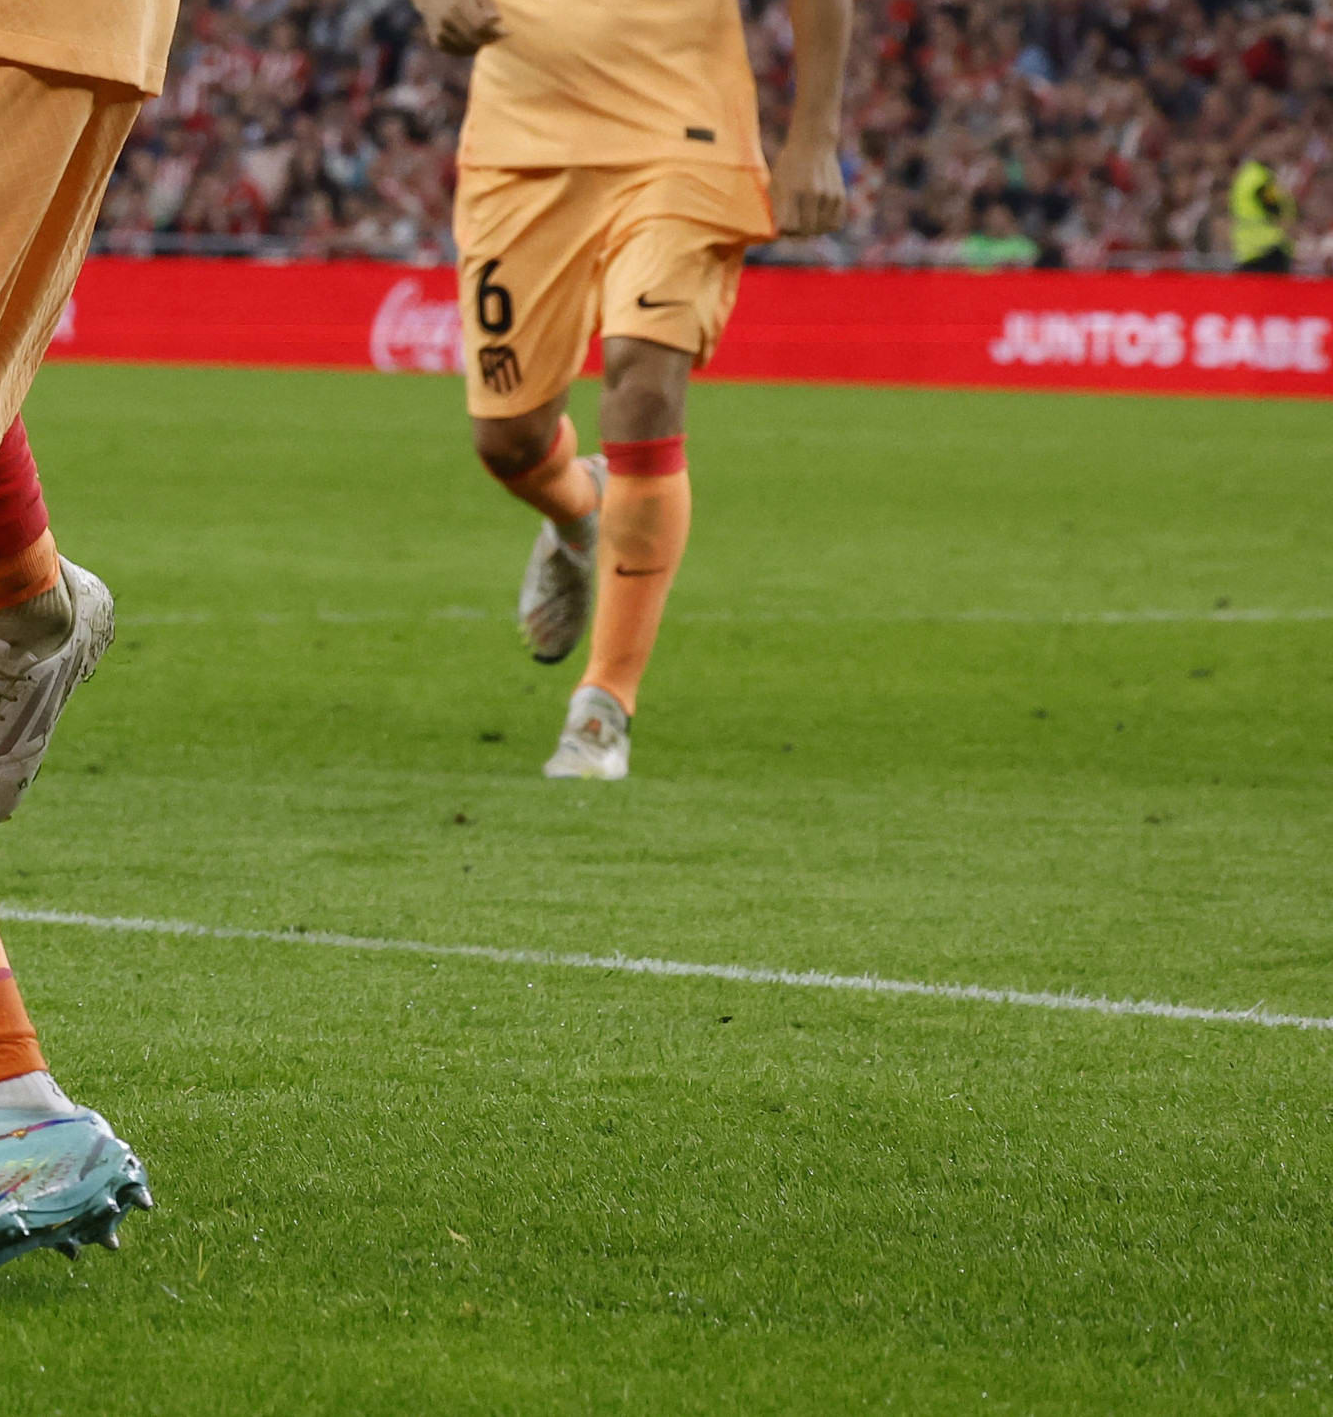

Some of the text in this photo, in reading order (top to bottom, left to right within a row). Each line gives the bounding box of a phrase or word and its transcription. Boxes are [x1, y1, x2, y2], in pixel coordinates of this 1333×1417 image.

[478, 258, 513, 336] 6
[989, 311, 1332, 372] JUNTOS SABE
